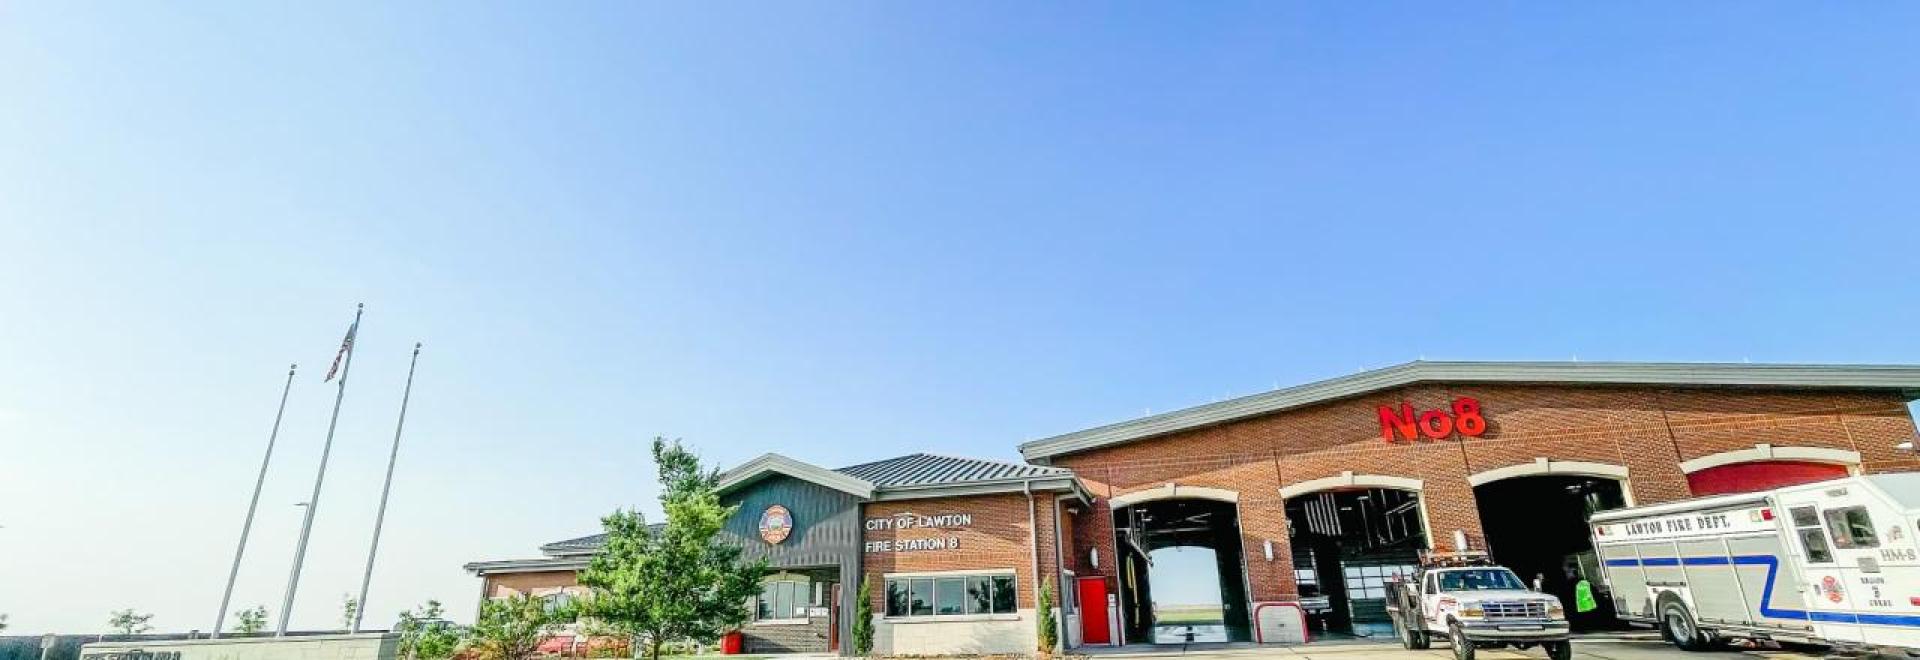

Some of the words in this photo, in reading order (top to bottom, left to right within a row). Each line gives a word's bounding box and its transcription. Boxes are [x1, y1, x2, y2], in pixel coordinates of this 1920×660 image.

[1379, 397, 1486, 443] No8
[866, 518, 893, 530] CITY
[897, 517, 914, 528] OF
[919, 514, 972, 528] LAWTON
[1625, 521, 1663, 535] LAWTON
[1666, 518, 1692, 532] FIRE
[865, 540, 891, 552] FIRE
[895, 538, 945, 551] STATION
[950, 537, 958, 549] 8
